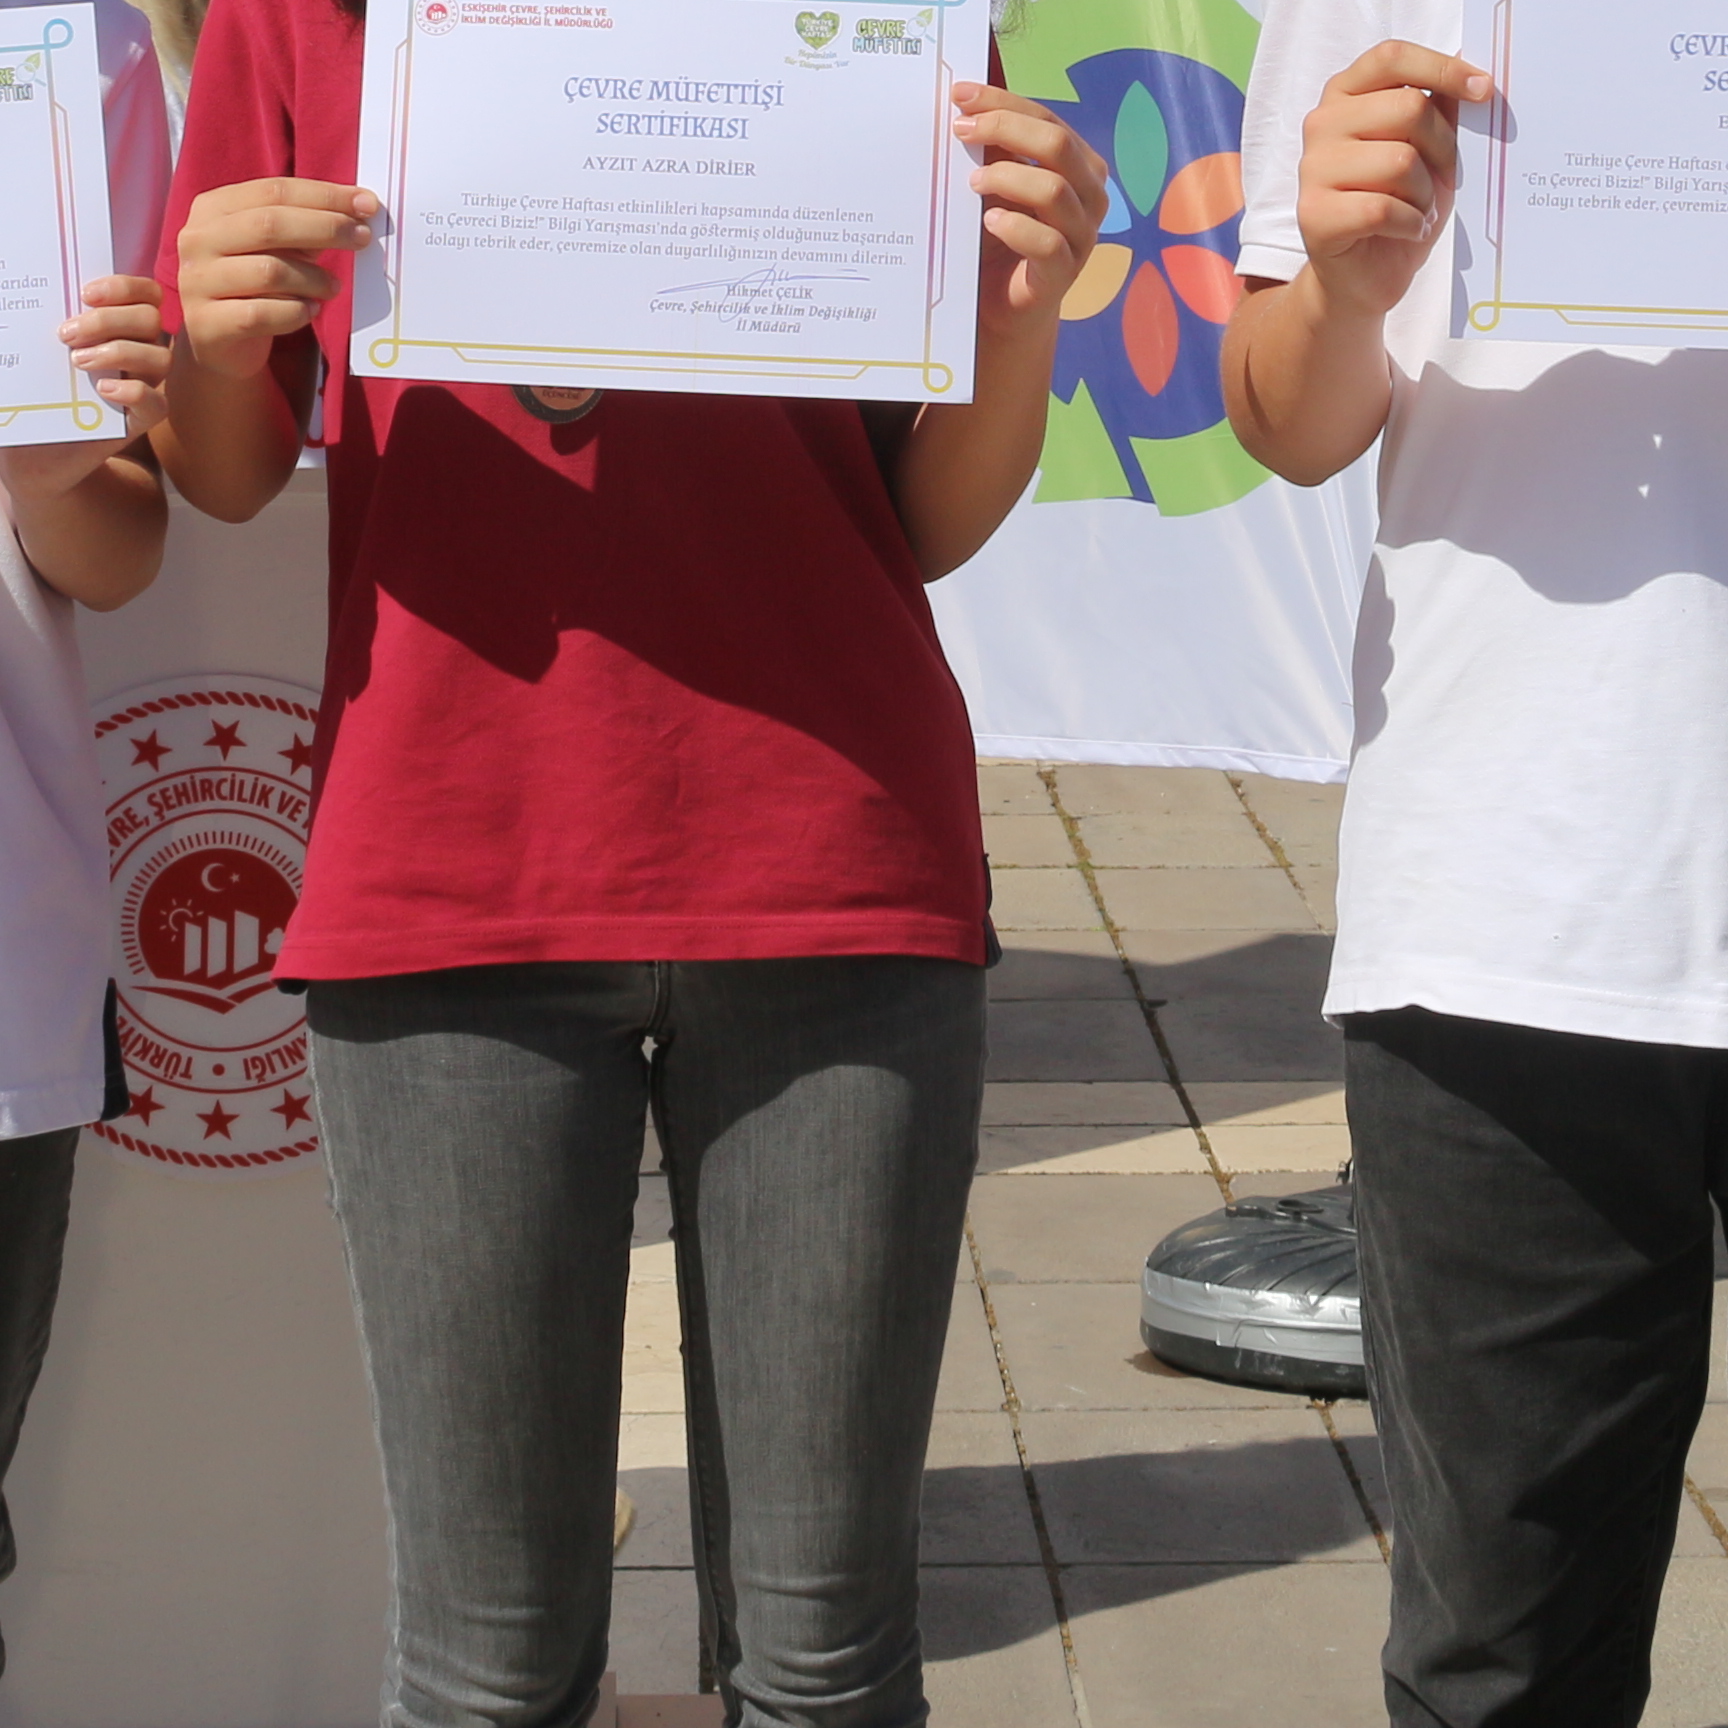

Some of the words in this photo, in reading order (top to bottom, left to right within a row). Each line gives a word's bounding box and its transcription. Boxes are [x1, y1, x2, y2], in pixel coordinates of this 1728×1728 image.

[460, 1, 507, 14] ESKİŞEHİR
[508, 4, 541, 15] ÇEVRE,
[543, 4, 592, 17] ŞEHİRCİLİK
[594, 7, 607, 17] VE
[460, 13, 486, 24] İKLİM
[487, 14, 542, 27] DEĞİŞİKLİĞİ
[542, 15, 552, 27] İL
[553, 16, 613, 29] MÜDÜRLÜĞÜ
[563, 76, 644, 103] ÇEVRE
[646, 75, 784, 111] MÜFETTİŞİ
[595, 109, 749, 140] SERTİFİKASI
[640, 158, 691, 174] AZRA
[695, 158, 756, 177] DİRİER
[1563, 152, 1622, 170] Türkiye
[1623, 153, 1665, 171] Çevre
[1666, 154, 1722, 172] Haftası
[460, 192, 517, 211] Türkiye
[519, 194, 559, 212] Çevre
[560, 196, 614, 213] Haftası
[616, 198, 697, 216] etkinlikleri
[700, 201, 789, 220] kapsamında
[791, 205, 873, 223] düzenlenen
[446, 211, 497, 229] Çevreci
[547, 216, 581, 234] Bilgi
[689, 222, 760, 242] göstermiş
[761, 224, 839, 244] olduğunuz
[841, 227, 914, 246] başarıdan
[424, 231, 470, 250] dolayı
[473, 233, 516, 249] tebrik
[518, 235, 554, 252] eder,
[555, 239, 627, 254] çevremize
[628, 239, 661, 256] olan
[664, 241, 778, 266] duyarlılığınızın
[780, 246, 848, 263] devamını
[850, 249, 906, 265] dilerim.
[147, 773, 275, 821] ŞEHİRCİLİK
[276, 790, 307, 823] VE
